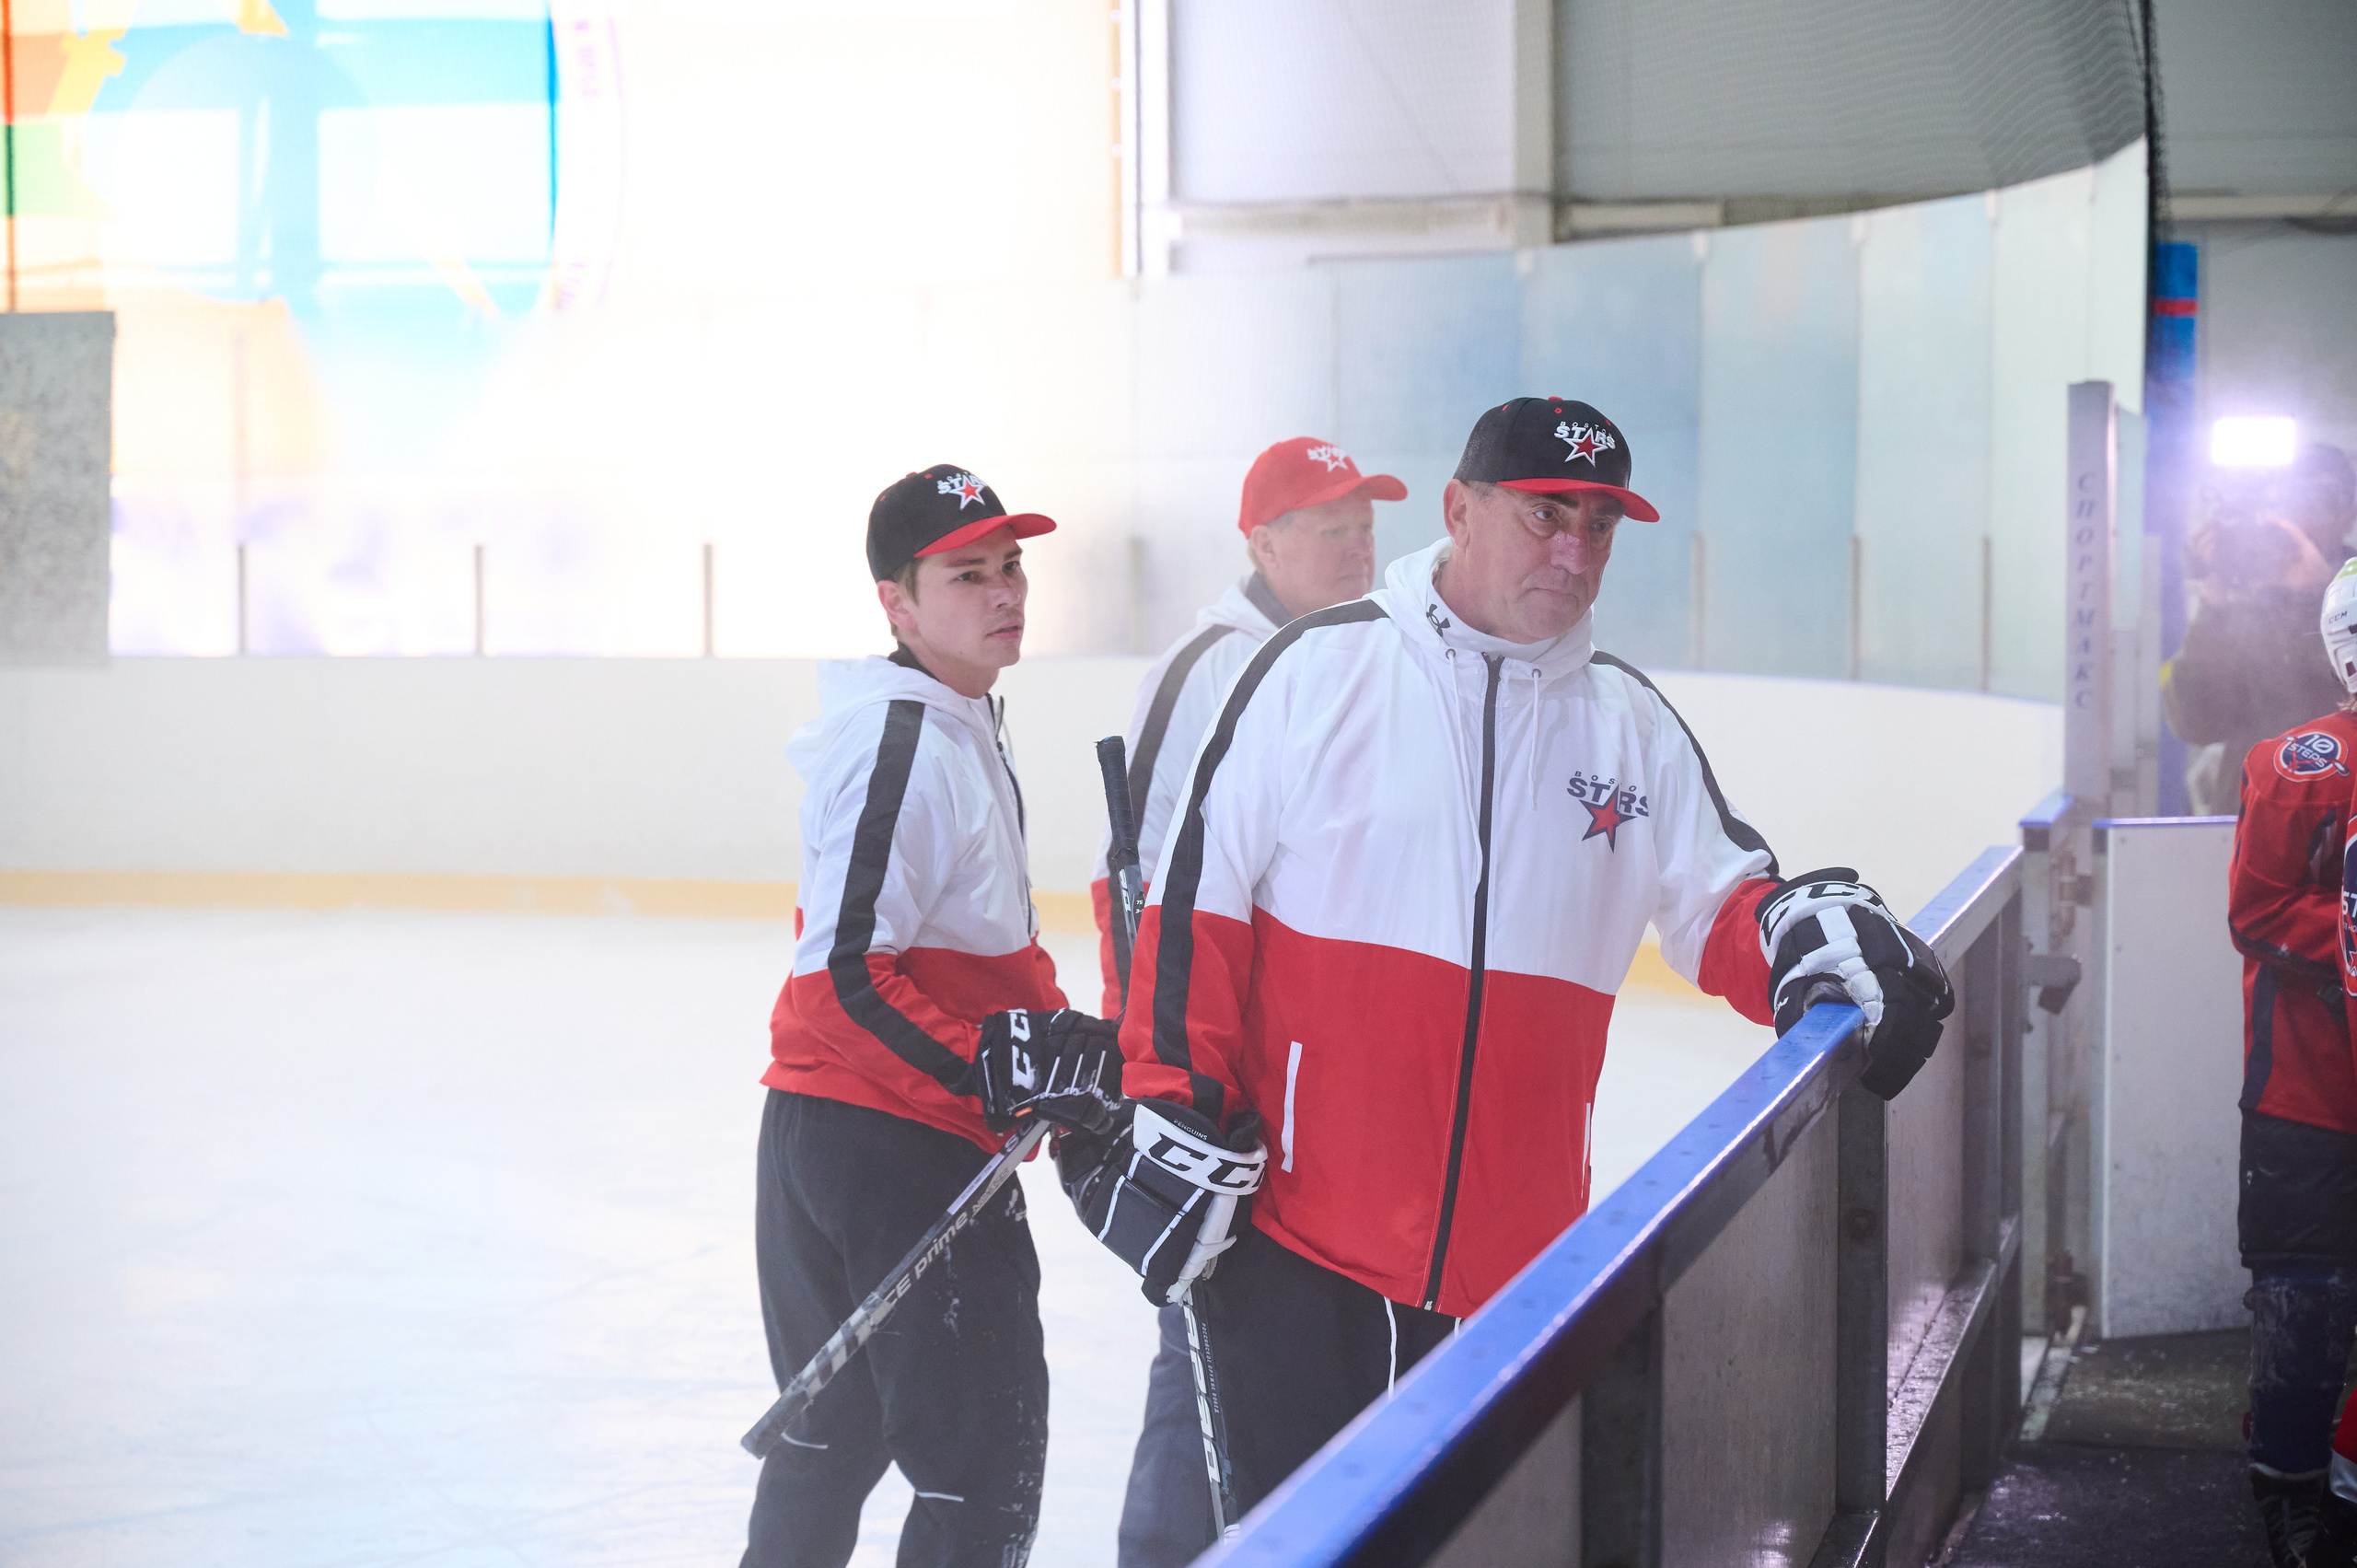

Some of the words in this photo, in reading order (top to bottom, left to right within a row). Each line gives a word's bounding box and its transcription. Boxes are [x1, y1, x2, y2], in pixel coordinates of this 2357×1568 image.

[1554, 425, 1616, 449] STARS
[2328, 610, 2348, 624] CCM
[2287, 743, 2328, 768] STEPS
[2304, 734, 2335, 754] 10
[1566, 777, 1650, 818] STARS
[1007, 1008, 1035, 1090] CC
[1173, 1119, 1208, 1141] PENGUINS
[914, 1211, 970, 1280] prime
